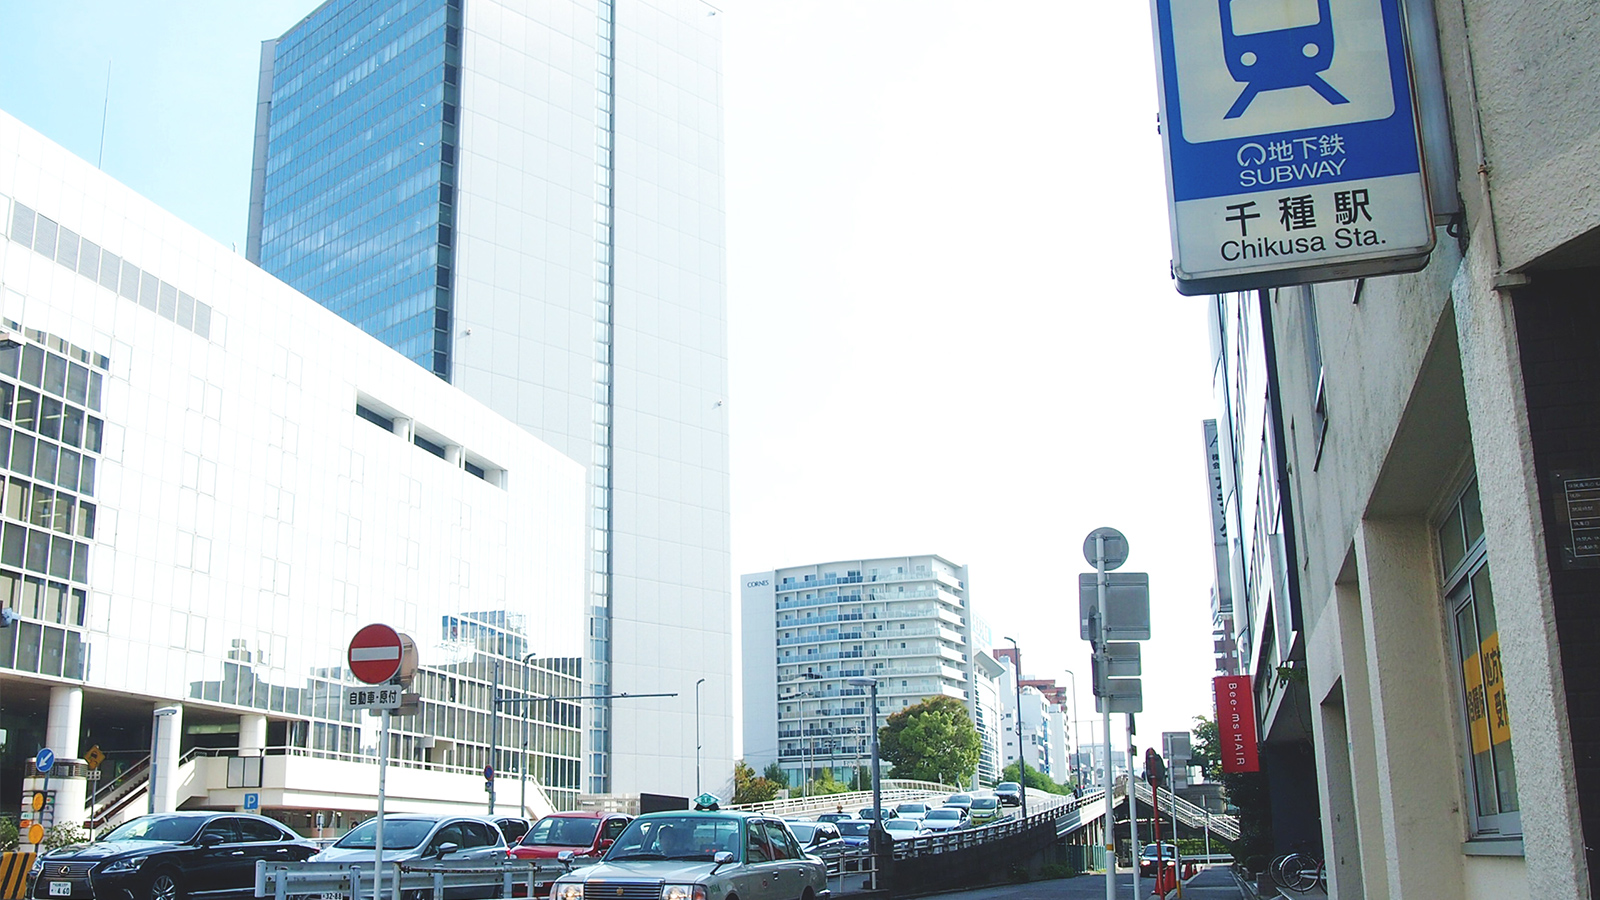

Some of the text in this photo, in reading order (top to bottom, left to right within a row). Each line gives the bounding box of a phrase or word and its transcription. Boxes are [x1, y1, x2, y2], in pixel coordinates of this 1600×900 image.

[1267, 133, 1346, 162] 地下鉄
[1239, 158, 1346, 187] SUBWAY
[1225, 188, 1373, 237] 千種駅
[1220, 227, 1386, 262] Chikusa Sta.
[1234, 733, 1245, 765] HAIR
